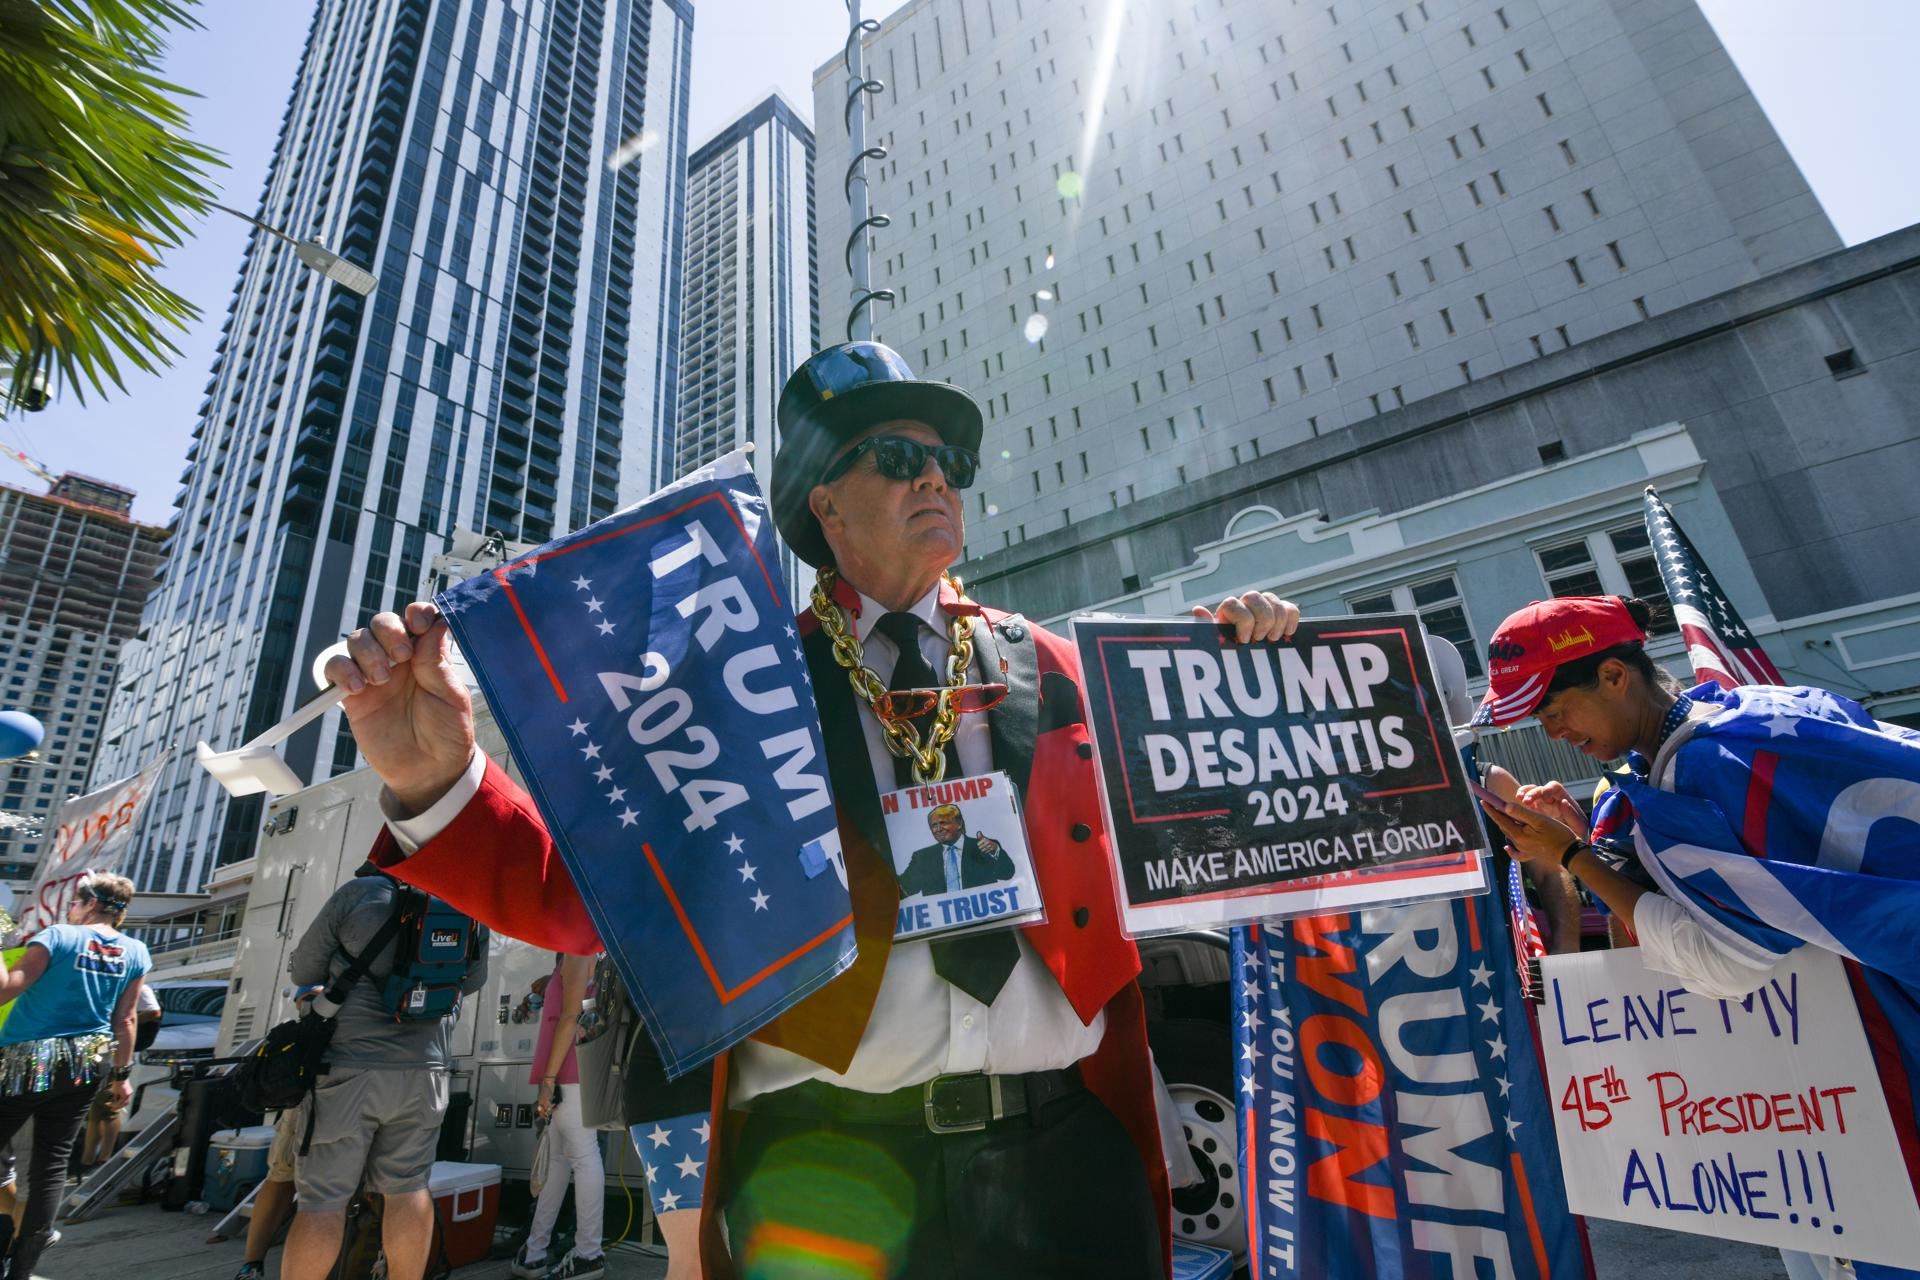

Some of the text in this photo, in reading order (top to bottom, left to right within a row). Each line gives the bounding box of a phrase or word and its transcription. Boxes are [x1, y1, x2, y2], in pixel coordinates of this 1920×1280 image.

[649, 520, 849, 893] TRUMP
[1127, 643, 1389, 721] TRUMP
[597, 651, 750, 833] 2024
[1143, 716, 1414, 792] DESANTIS
[882, 778, 993, 815] N TRUMP
[1247, 783, 1348, 826] 2024
[1144, 820, 1464, 891] MAKE AMERICA FLORIDA
[895, 886, 1019, 933] WE TRUST
[1269, 949, 1285, 990] IT.
[1271, 1006, 1294, 1080] YOU
[1553, 977, 1697, 1045] LEAVE
[1292, 912, 1397, 1220] WON
[1361, 900, 1516, 1280] RUMP
[1561, 1065, 1857, 1137] 45th PRESIDENT
[1268, 1090, 1296, 1215] KNOW
[1622, 1148, 1844, 1235] ALONE!!!
[1268, 1225, 1294, 1277] IT.
